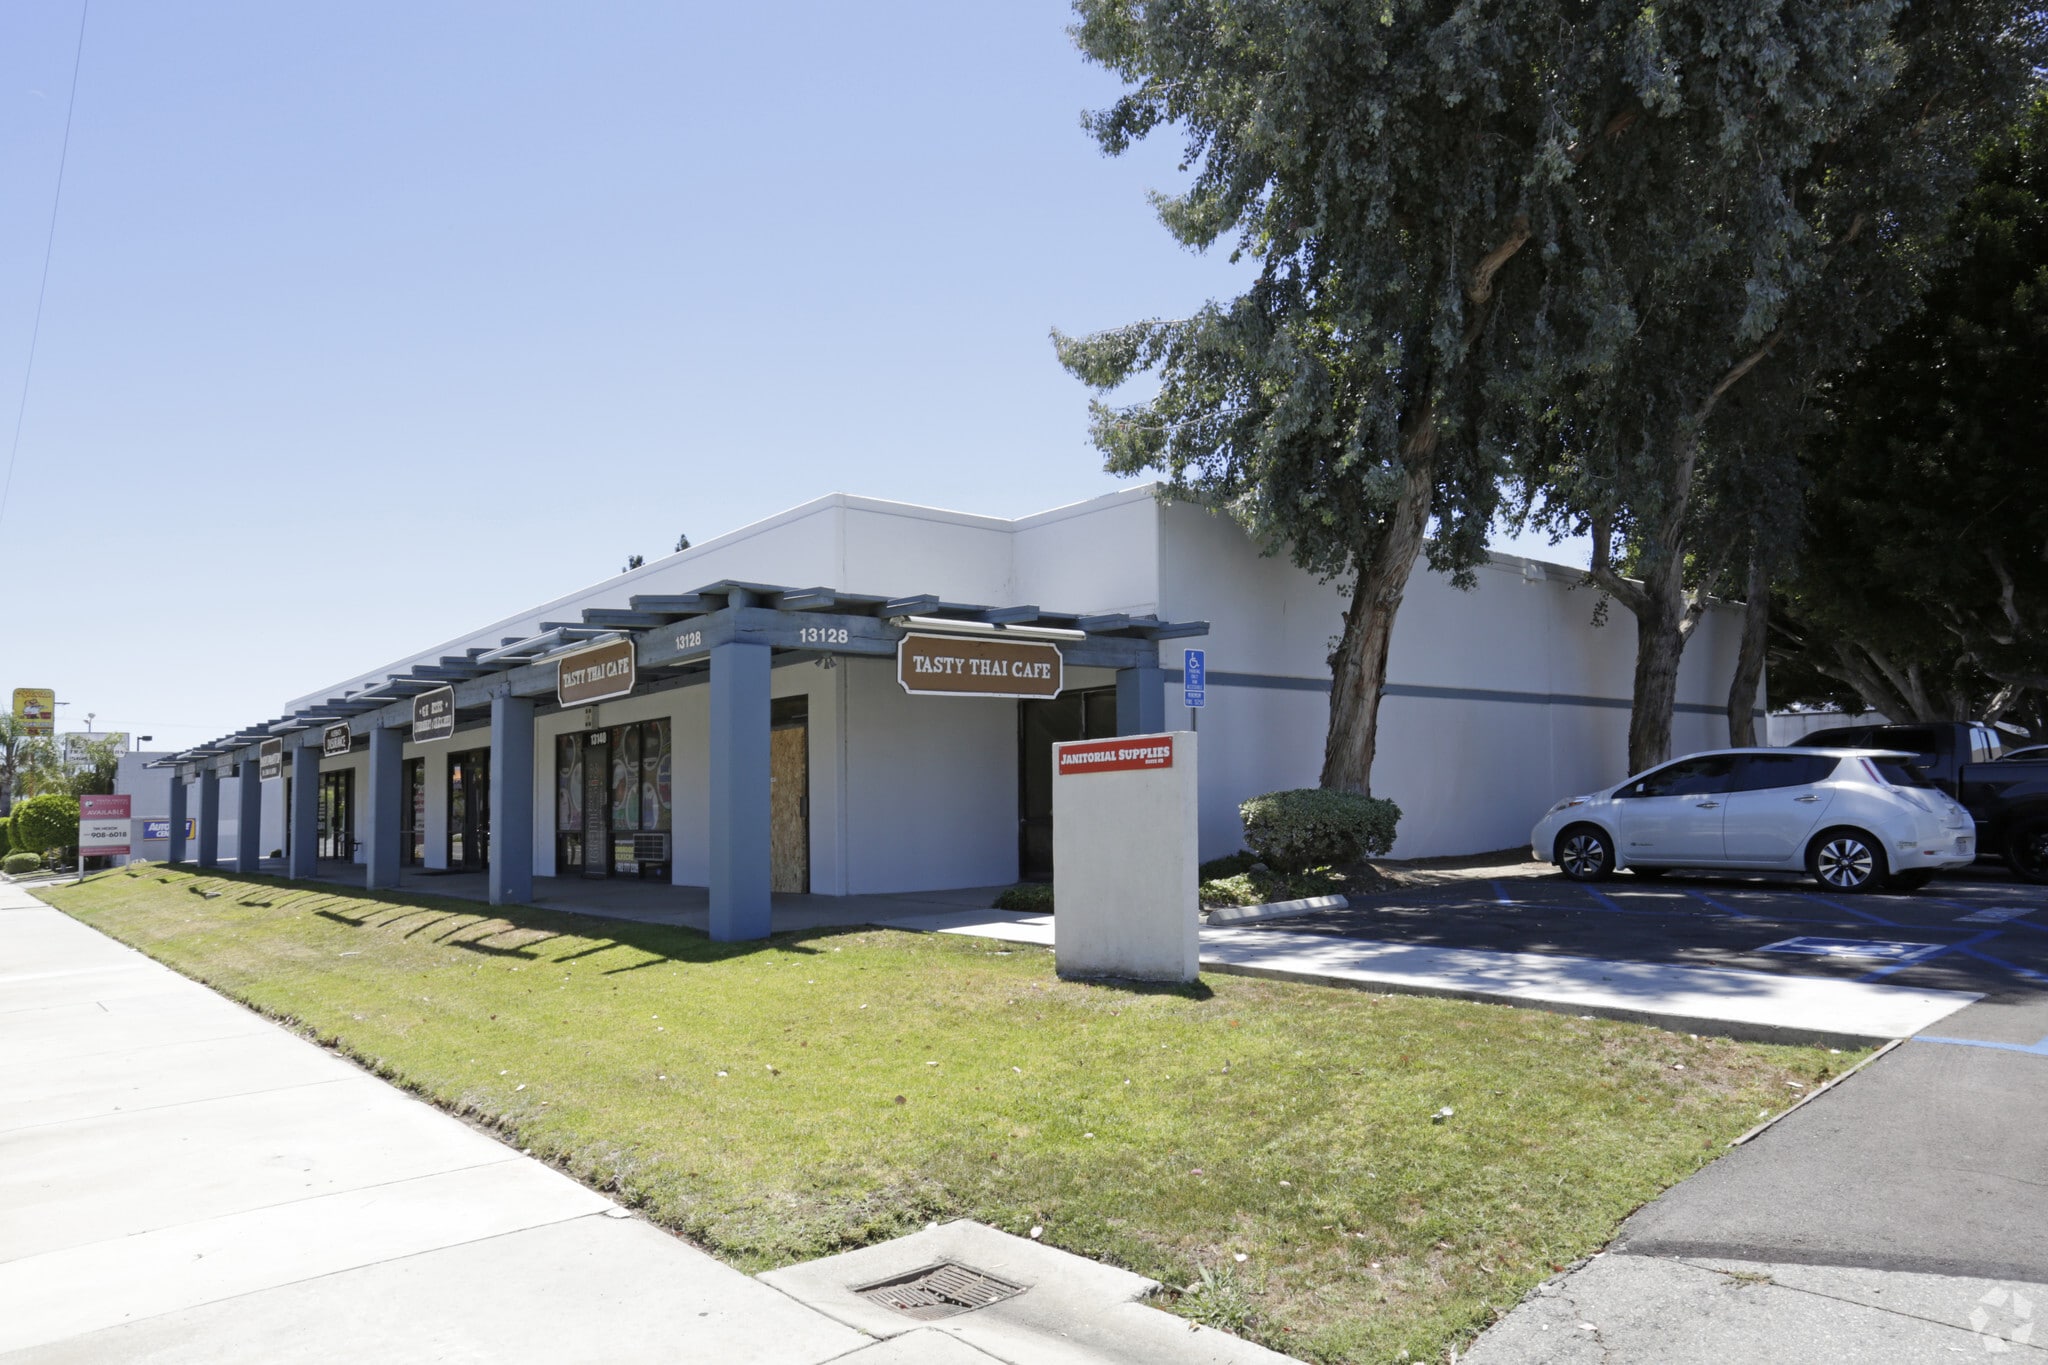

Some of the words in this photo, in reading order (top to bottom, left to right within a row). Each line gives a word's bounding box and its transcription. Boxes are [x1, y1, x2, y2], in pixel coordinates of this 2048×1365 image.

[675, 631, 701, 650] 13128
[800, 628, 848, 644] 13128
[563, 669, 585, 688] TASTY
[587, 663, 606, 682] THAI
[607, 657, 629, 677] CAFE
[913, 655, 965, 674] TASTY
[969, 658, 1008, 676] THAI
[1012, 661, 1051, 679] CAFE
[1061, 750, 1117, 765] JANITORIAL
[1118, 746, 1170, 760] SUPPLIES
